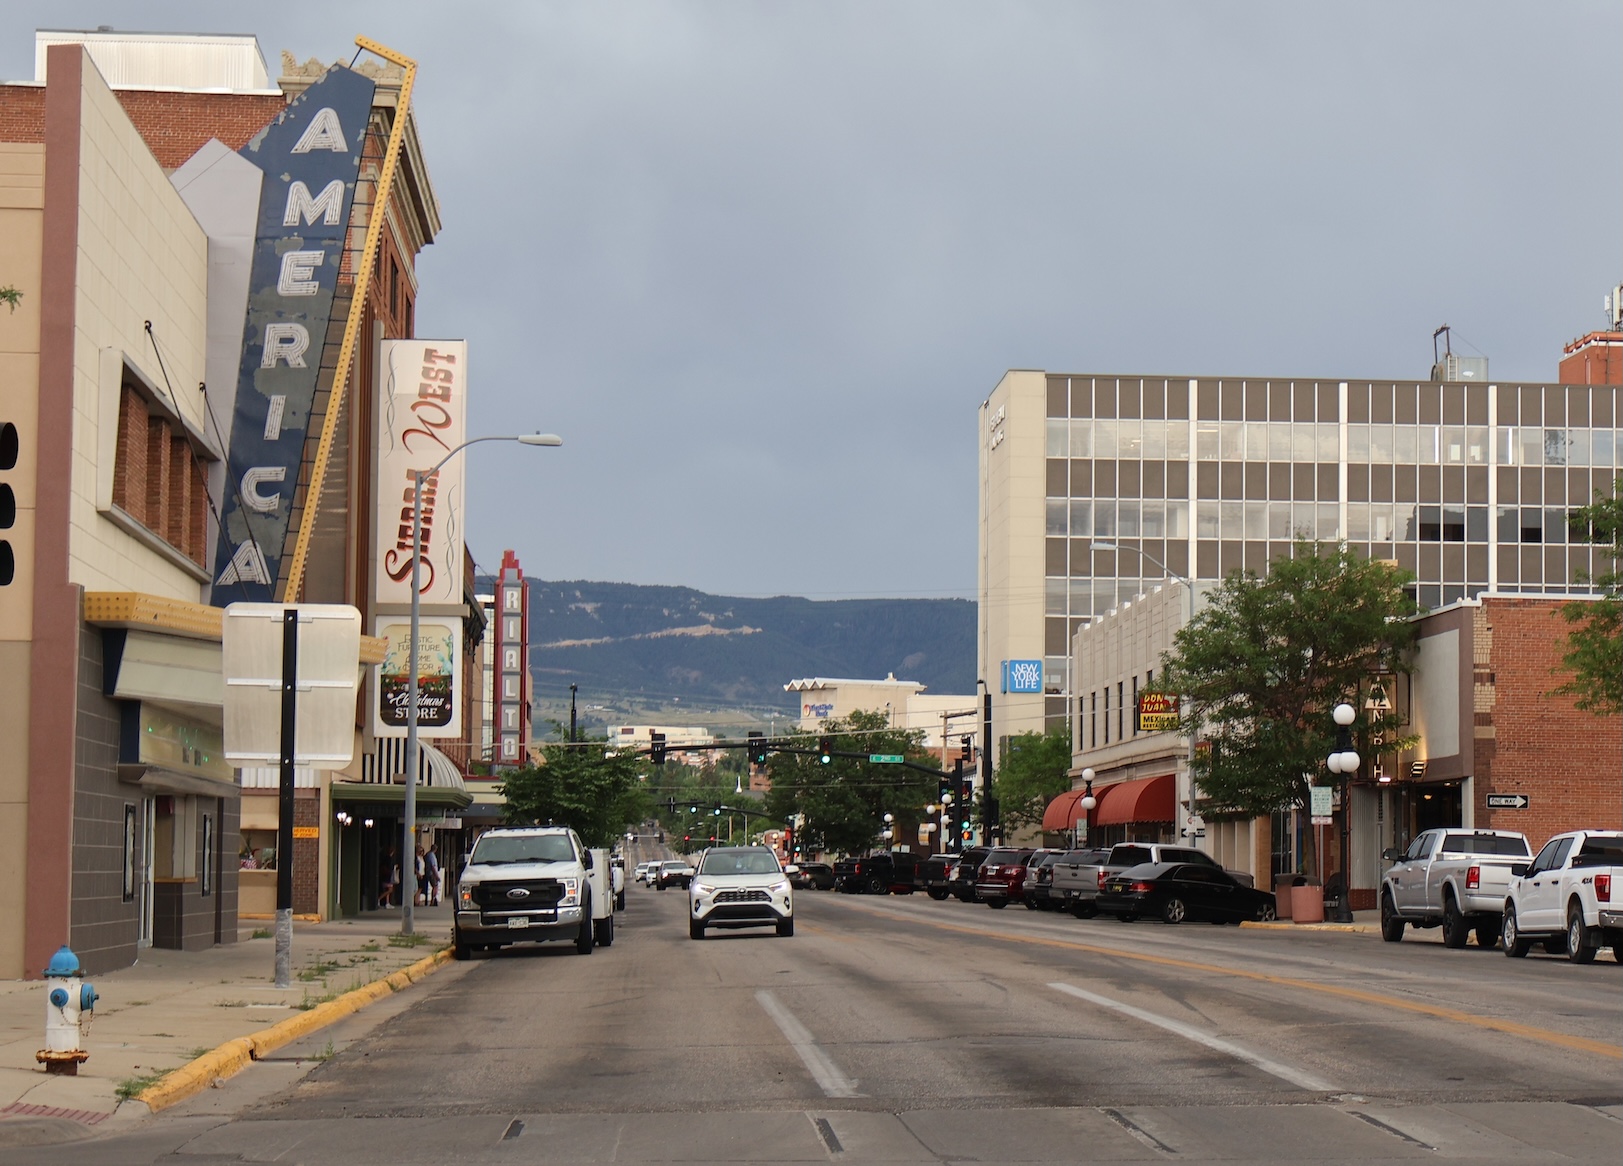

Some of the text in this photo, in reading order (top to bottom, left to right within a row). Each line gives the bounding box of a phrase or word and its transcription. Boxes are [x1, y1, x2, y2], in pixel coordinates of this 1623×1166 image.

[215, 107, 349, 586] AMERICA
[402, 348, 456, 455] WEST
[404, 633, 433, 643] RSTIC
[397, 643, 441, 652] FURITURE
[402, 662, 434, 672] DCOR
[1015, 663, 1038, 672] NEW
[503, 590, 519, 755] RIALTO
[1011, 671, 1040, 681] YORK
[1015, 679, 1038, 689] LIFE
[389, 692, 445, 707] Chstmas
[1144, 694, 1164, 703] DON
[1142, 703, 1166, 713] JUAN
